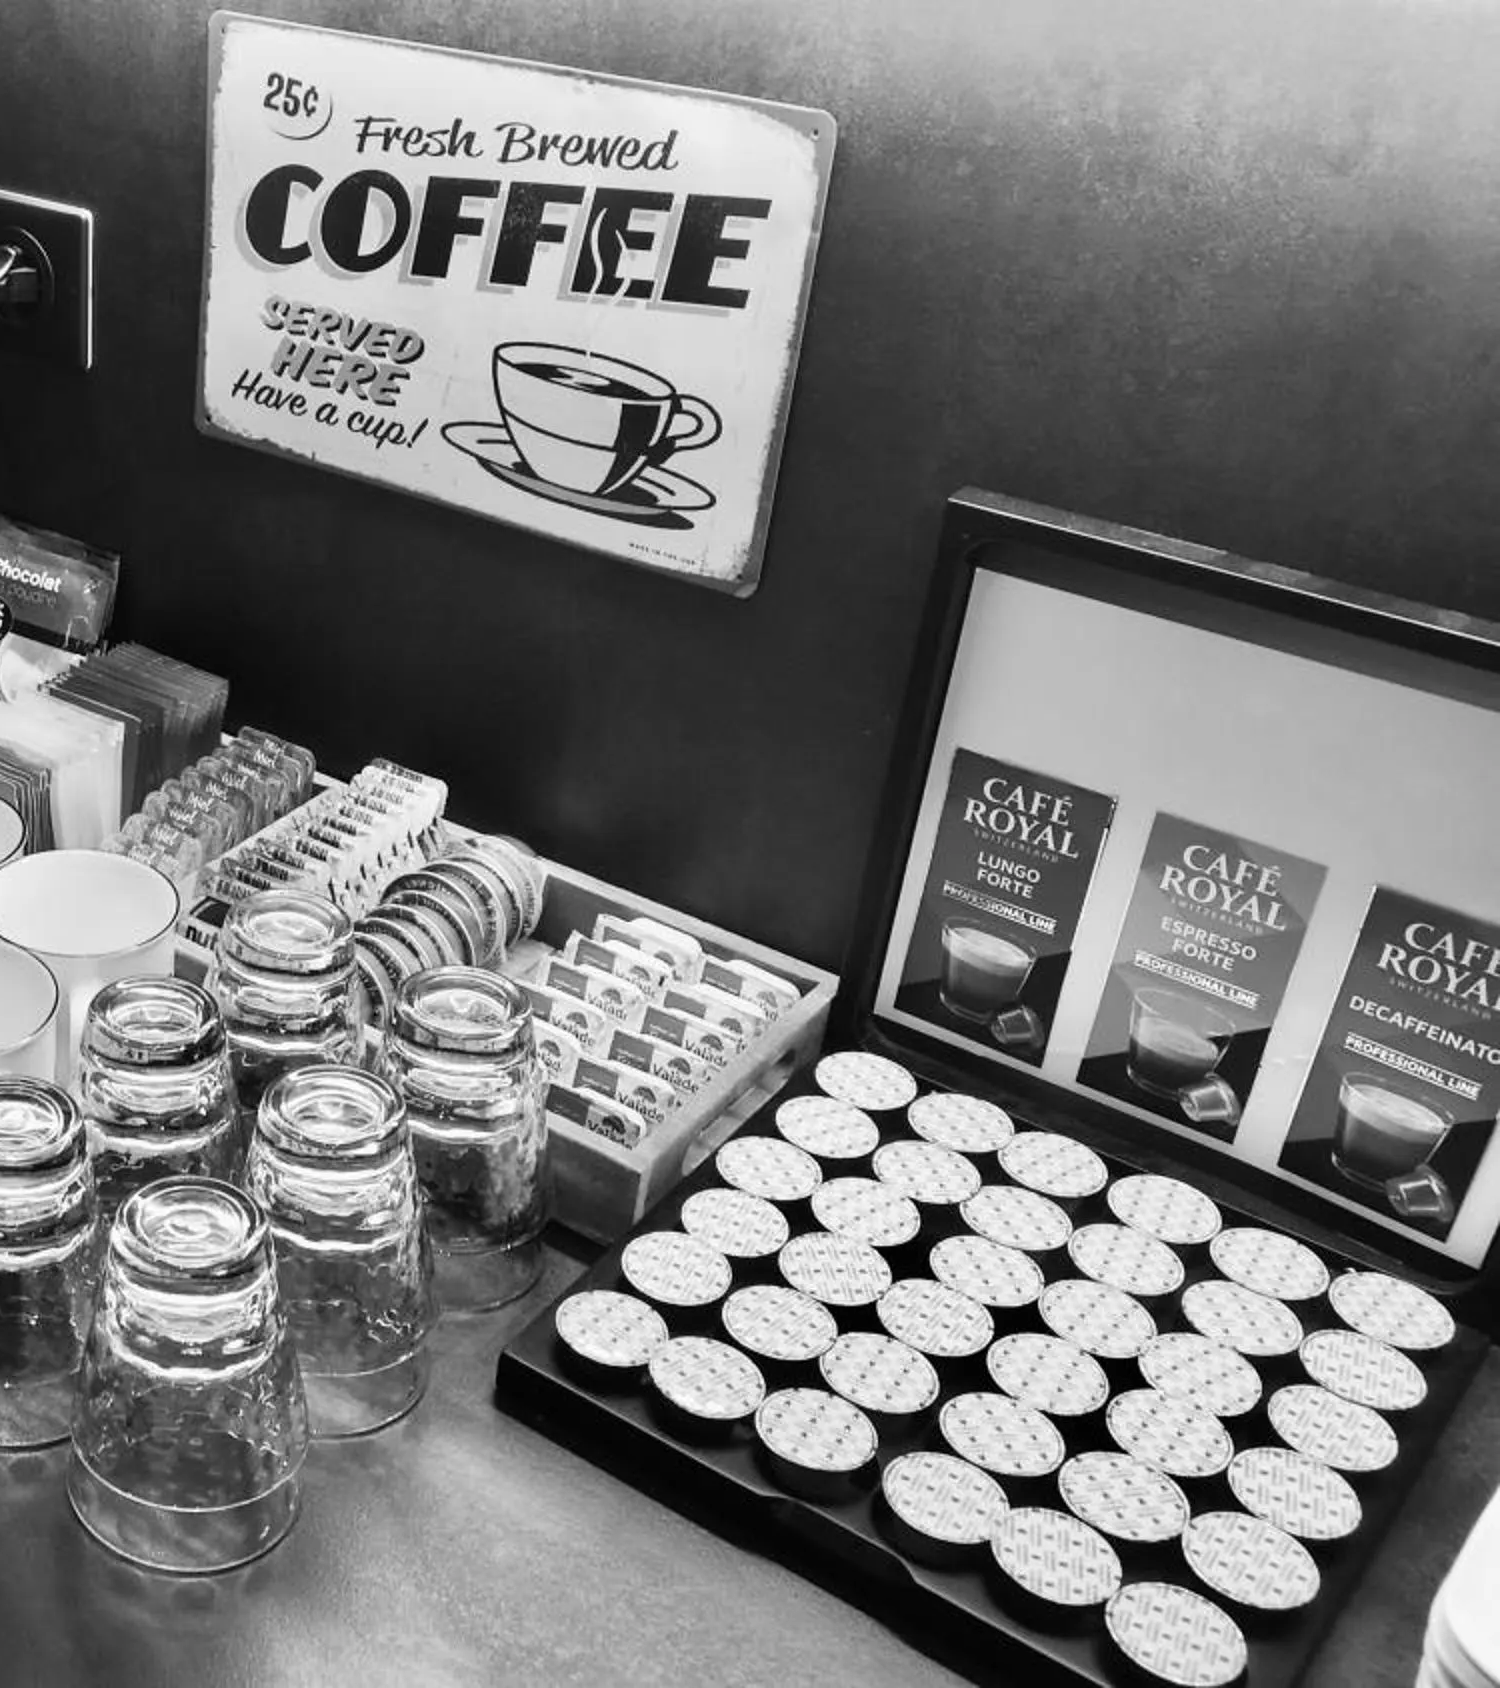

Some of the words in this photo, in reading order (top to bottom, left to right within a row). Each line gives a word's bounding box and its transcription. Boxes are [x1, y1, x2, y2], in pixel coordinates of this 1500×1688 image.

[263, 73, 319, 118] 25¢
[354, 116, 484, 159] Fresh
[494, 121, 680, 171] Brewed
[238, 164, 773, 314] COFFEE
[260, 294, 426, 365] SERVED
[271, 335, 411, 407] HERE
[231, 368, 308, 417] Have
[315, 402, 339, 426] a
[347, 411, 429, 450] cup!
[963, 797, 1079, 859] ROYAL
[983, 777, 1073, 827] CAFÉ
[977, 851, 1041, 883] LUNGO
[977, 869, 1034, 899] FORTE
[1183, 845, 1282, 897] CAFÉ
[1159, 864, 1286, 931] ROYAL
[1161, 916, 1257, 961] ESPRESSO
[1172, 937, 1236, 971] FORTE
[652, 1062, 699, 1094] Valade
[1345, 1035, 1445, 1083] PROFESSIONAL
[1449, 1077, 1481, 1098] LINE
[617, 1091, 665, 1123] Valade
